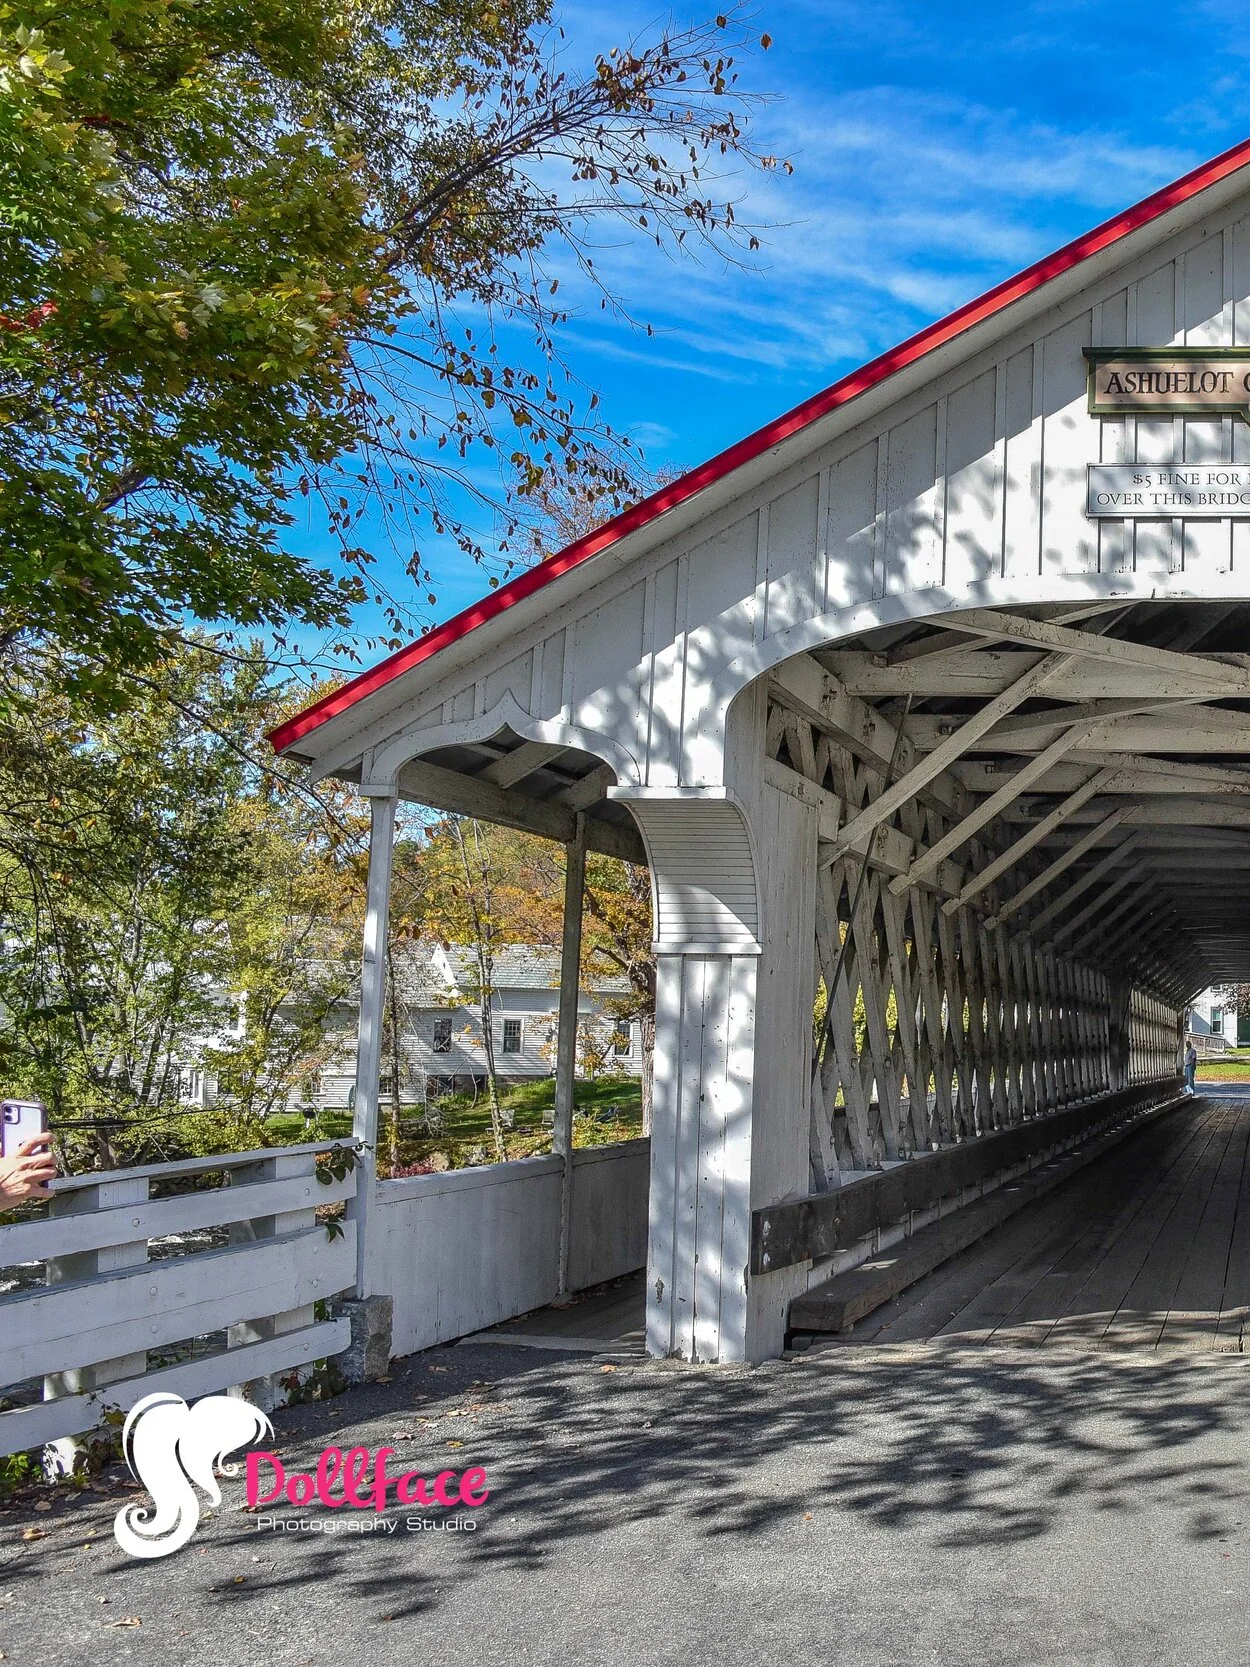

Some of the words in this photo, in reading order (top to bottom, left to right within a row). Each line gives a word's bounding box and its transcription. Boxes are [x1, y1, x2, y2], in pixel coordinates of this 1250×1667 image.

[1103, 371, 1234, 395] ASHUELOT
[1133, 473, 1152, 488] $5
[1158, 473, 1199, 486] FINE
[1207, 473, 1242, 486] FOR
[1096, 492, 1144, 505] OVER
[1150, 492, 1193, 505] THIS
